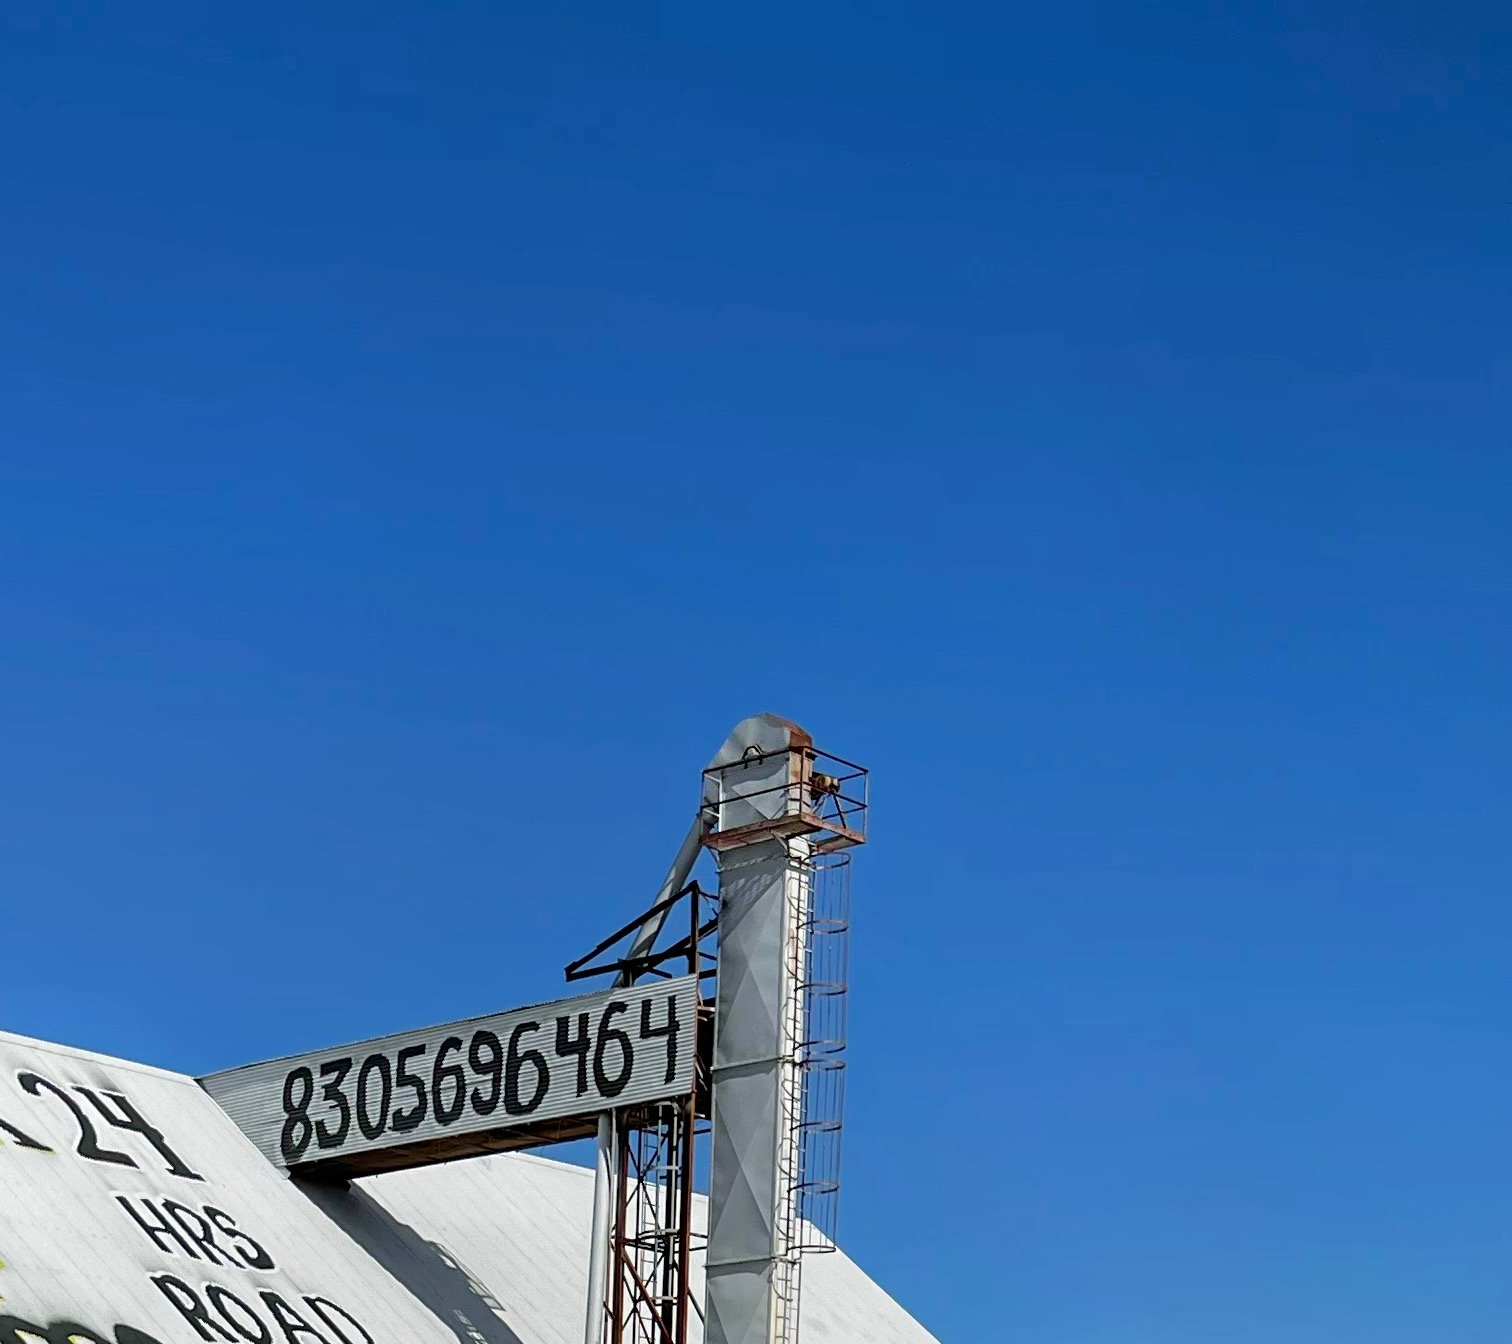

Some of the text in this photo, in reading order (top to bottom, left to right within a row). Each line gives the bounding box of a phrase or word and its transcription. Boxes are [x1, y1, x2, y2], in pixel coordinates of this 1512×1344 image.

[17, 1070, 206, 1181] 24
[279, 994, 681, 1164] 8305696464
[115, 1195, 276, 1271] HRS
